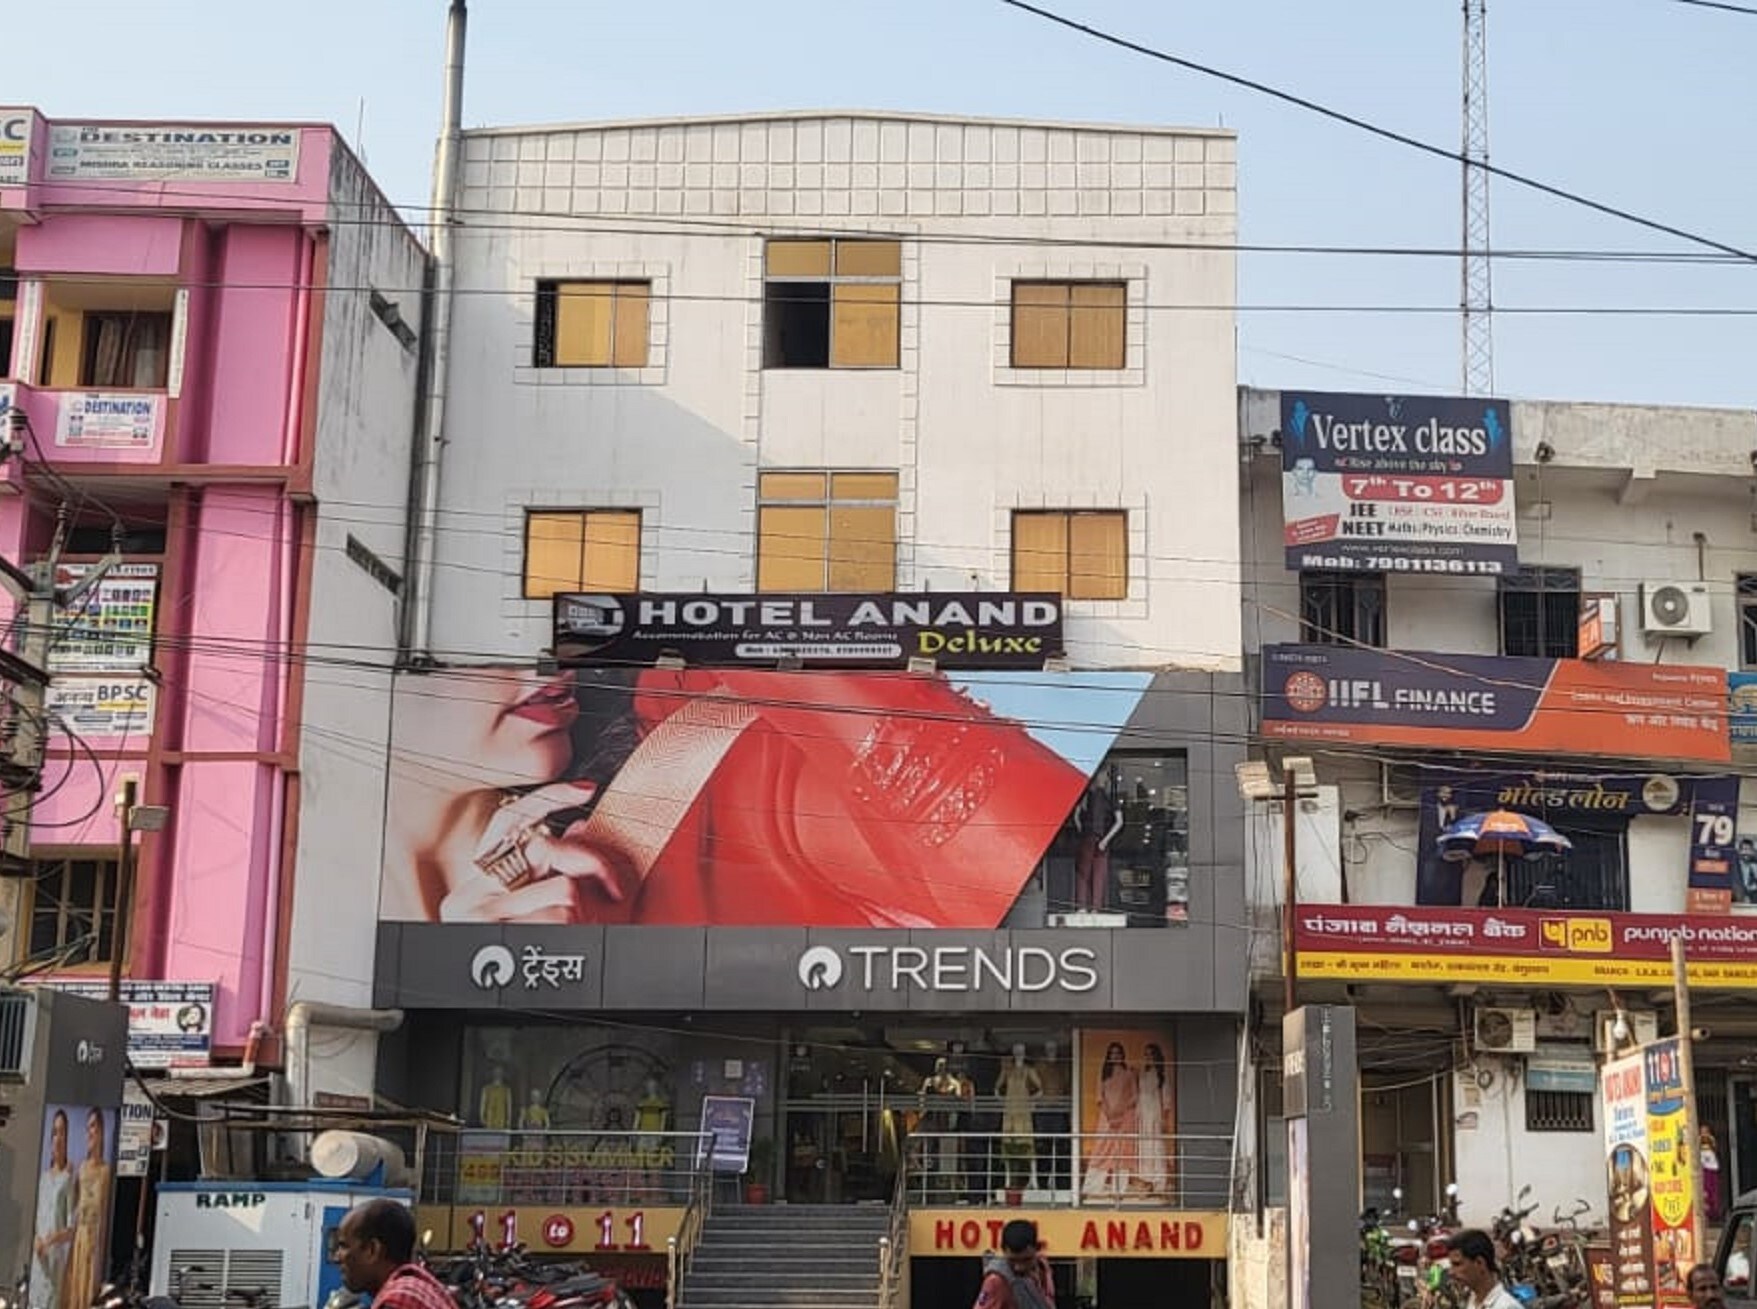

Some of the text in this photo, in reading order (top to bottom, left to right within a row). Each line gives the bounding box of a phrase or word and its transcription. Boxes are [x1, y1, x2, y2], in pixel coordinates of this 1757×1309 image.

[80, 132, 291, 145] DESTINATION
[84, 400, 150, 414] DESTINATION
[1311, 413, 1486, 455] Vertex class
[1350, 478, 1496, 500] 7th To 12th
[1350, 503, 1377, 517] JEE
[1343, 521, 1385, 536] NEET
[1463, 524, 1512, 539] Chemistry
[1302, 555, 1360, 569] Mob:
[639, 601, 1057, 626] HOTEL ANAND
[917, 630, 1042, 653] Deluxe
[98, 686, 148, 700] BPSC
[1329, 680, 1496, 714] IIFL FINANCE
[1695, 815, 1734, 845] 79
[1303, 915, 1378, 934] पंजाब
[1483, 917, 1526, 938] बैंक
[1571, 922, 1609, 945] pnb
[1624, 924, 1696, 943] punjab
[849, 947, 1098, 990] TRENDS
[196, 1194, 266, 1209] RAMP
[467, 1210, 516, 1251] 11
[594, 1211, 651, 1250] 11
[935, 1219, 1204, 1249] HOTL ANAND
